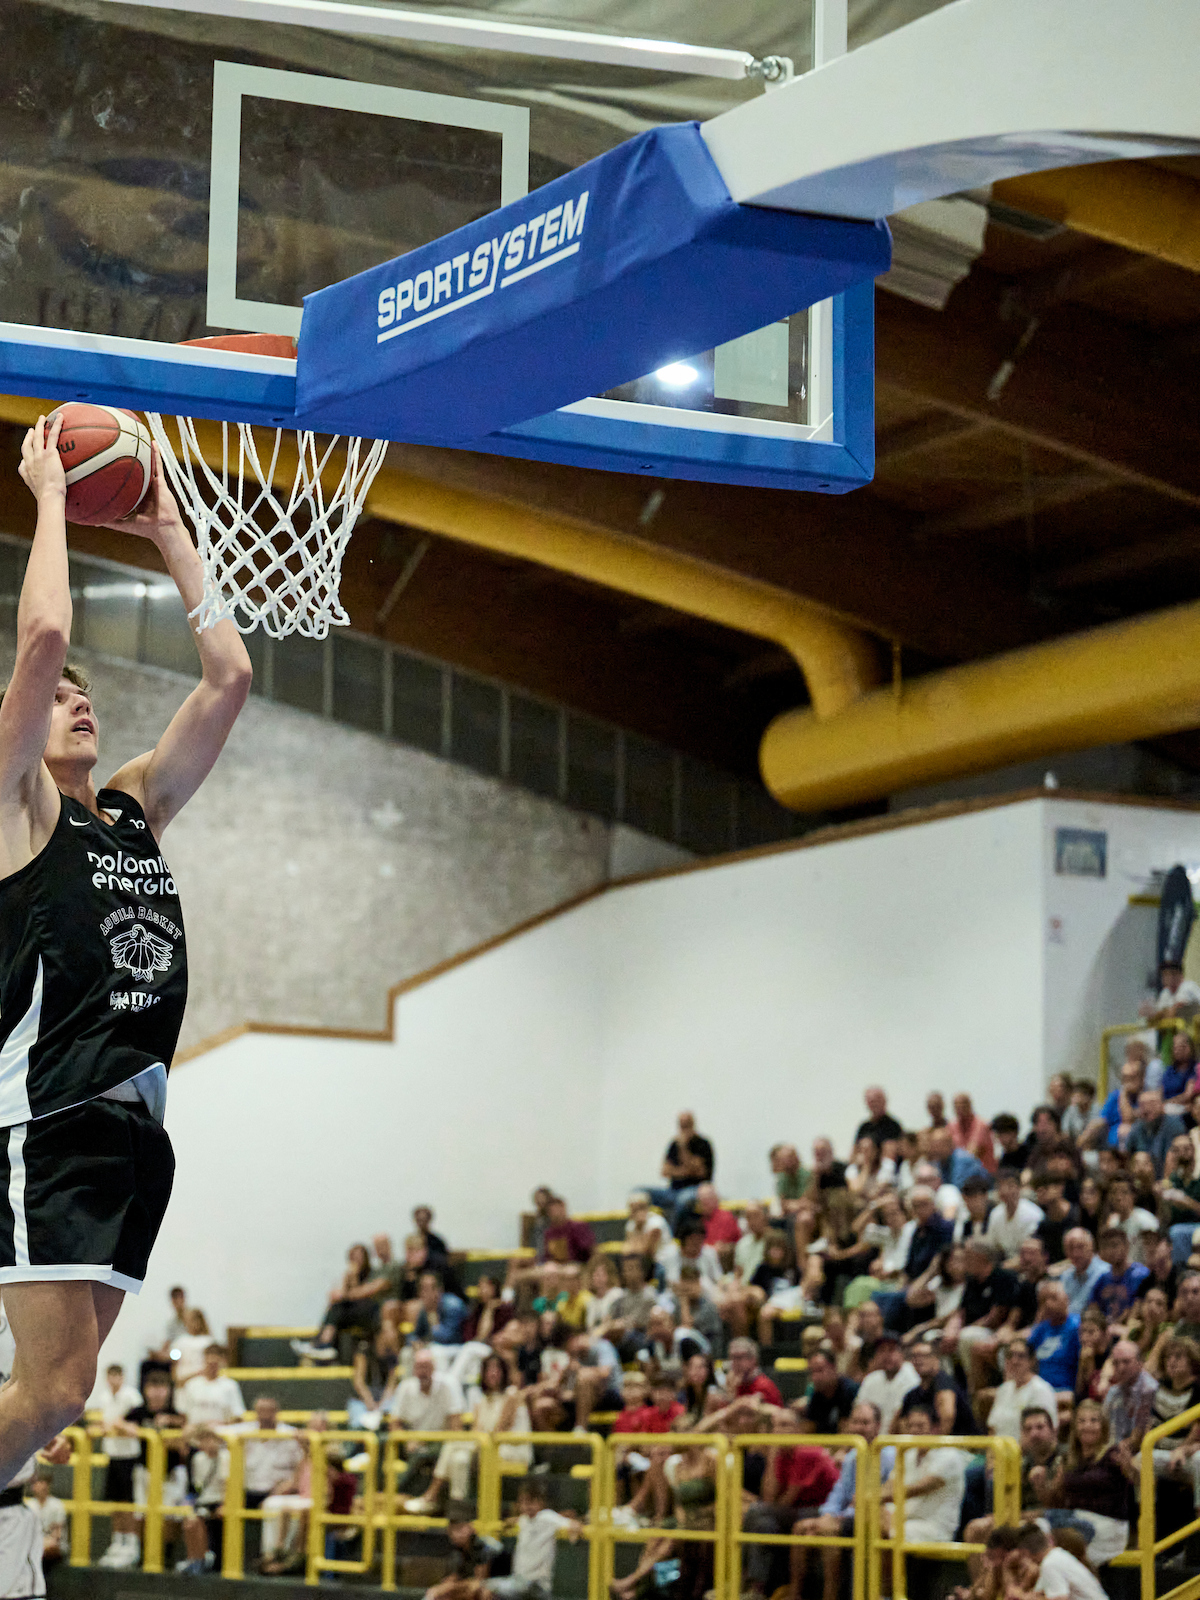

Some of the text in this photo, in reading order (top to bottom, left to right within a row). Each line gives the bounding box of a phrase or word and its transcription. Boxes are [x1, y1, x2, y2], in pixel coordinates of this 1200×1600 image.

[377, 190, 589, 329] SPORTSYSTEM
[99, 905, 183, 941] AQUILA BASKET
